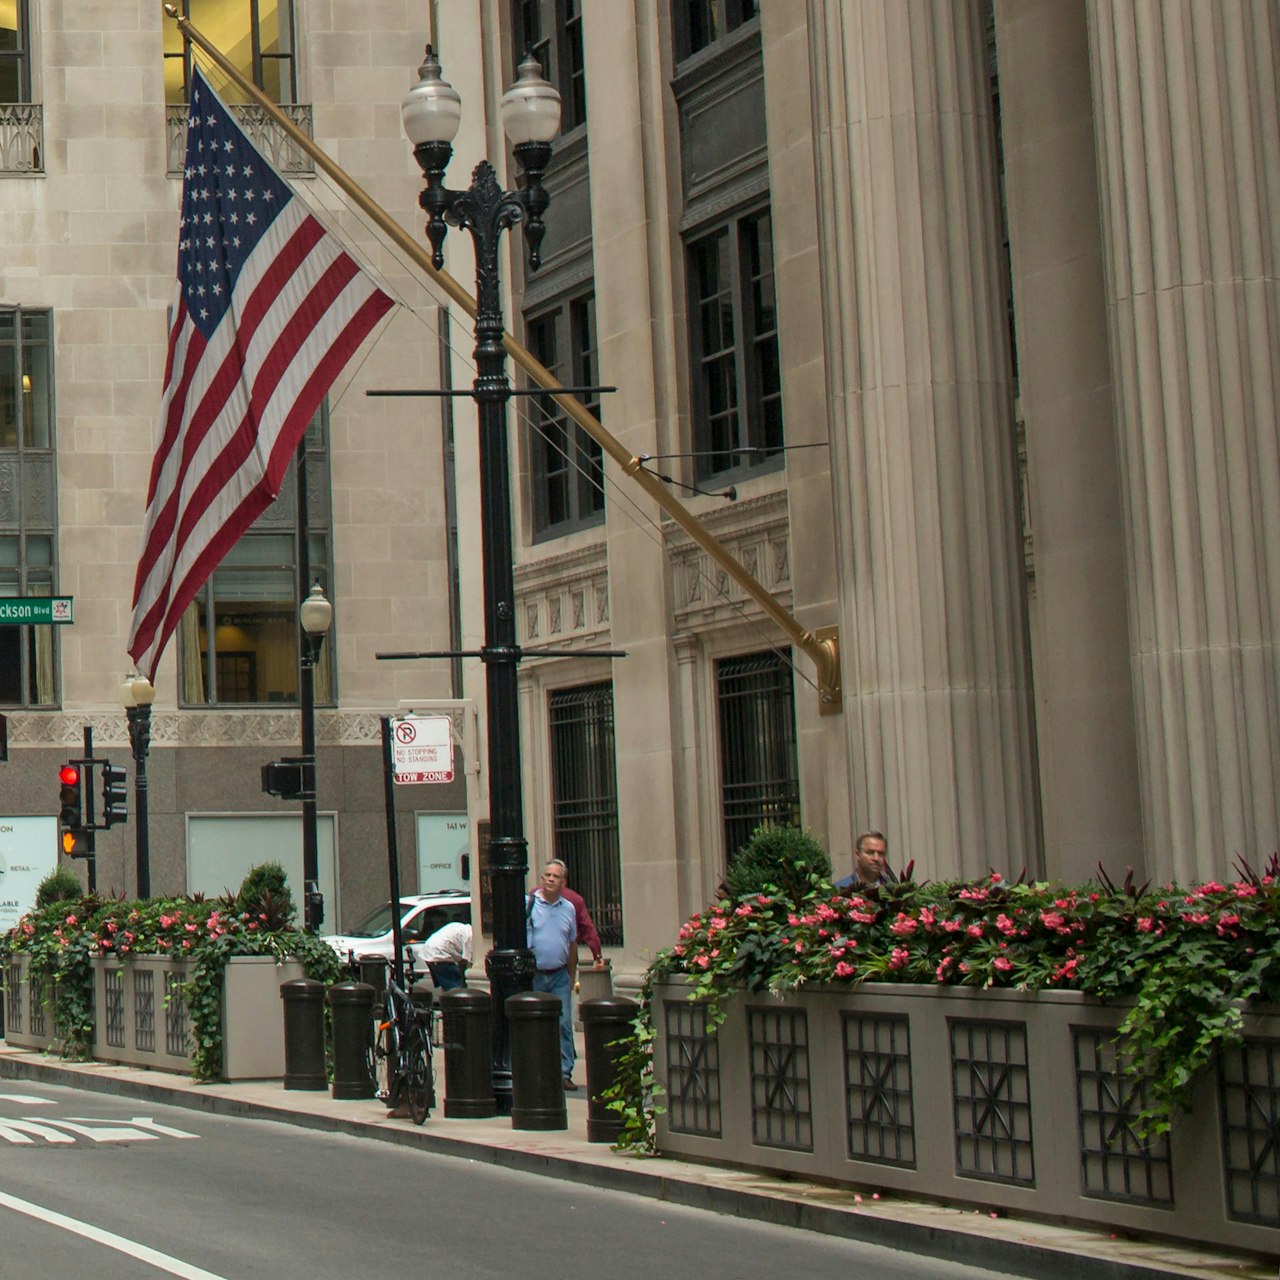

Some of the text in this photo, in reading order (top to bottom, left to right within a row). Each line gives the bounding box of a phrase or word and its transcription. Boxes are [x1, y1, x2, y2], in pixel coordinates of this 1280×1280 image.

[34, 606, 50, 615] Blvd
[408, 748, 438, 756] STOPPING
[398, 772, 448, 781] TOW ZONE
[446, 822, 457, 830] 141
